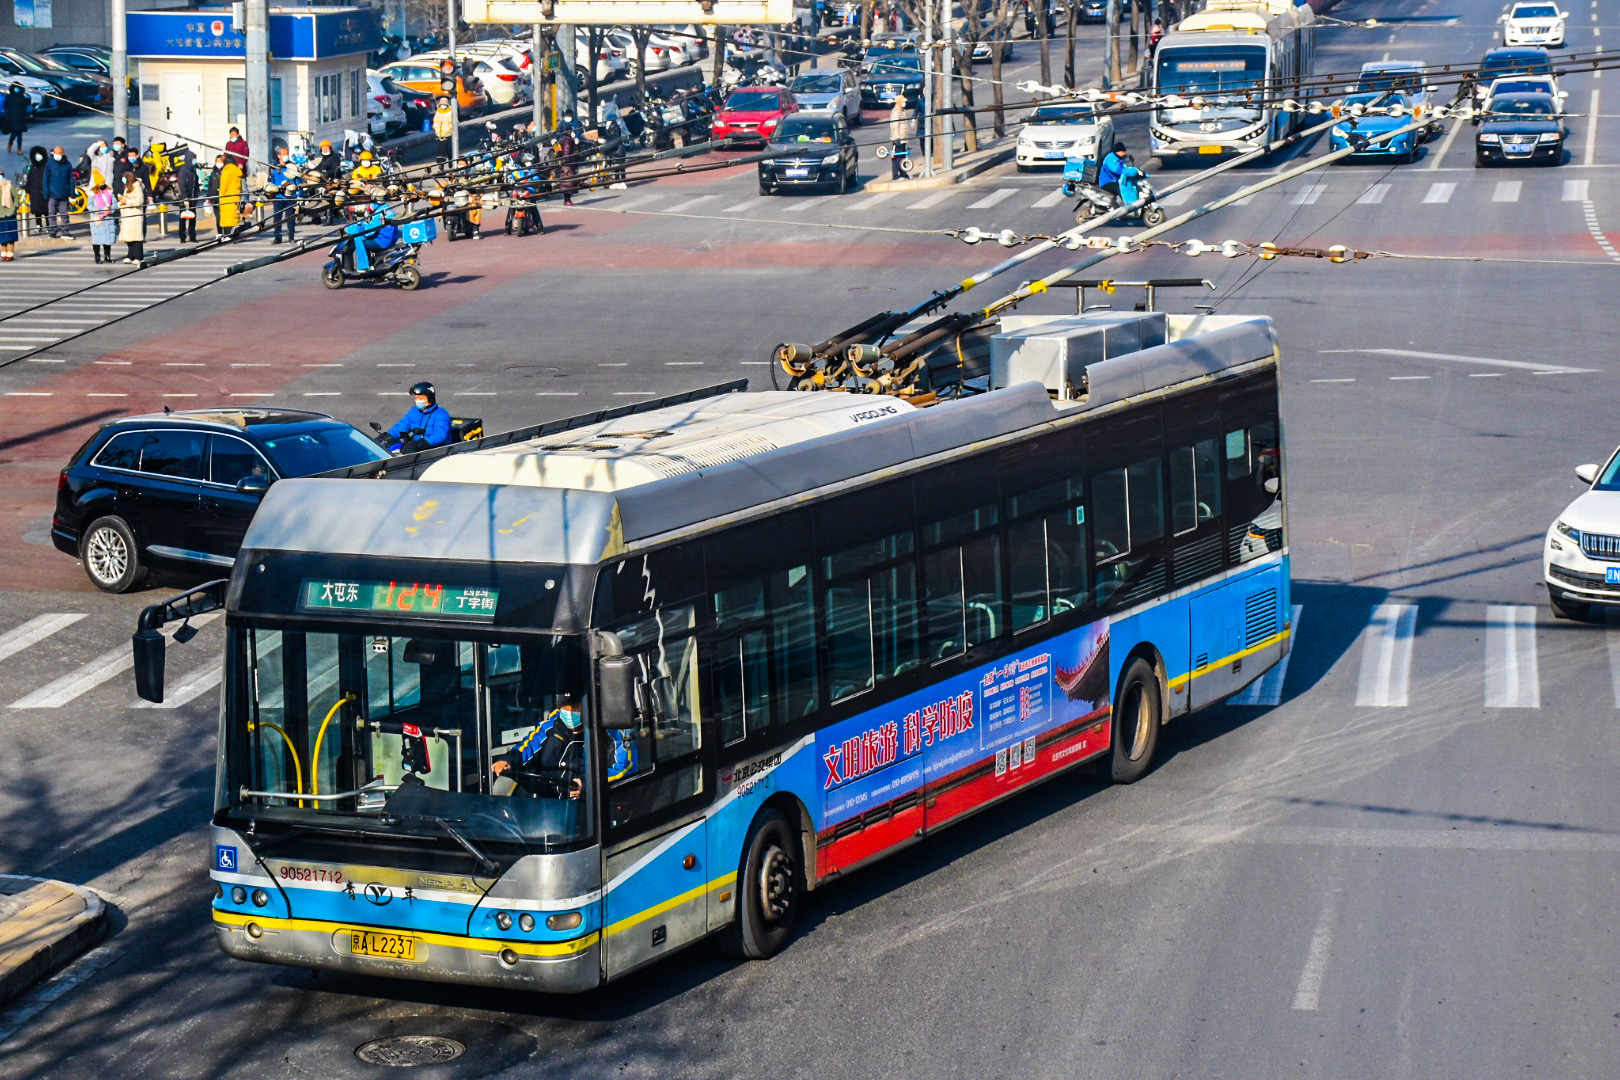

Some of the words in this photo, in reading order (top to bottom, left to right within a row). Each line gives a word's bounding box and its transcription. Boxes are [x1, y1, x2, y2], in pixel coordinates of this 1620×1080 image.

[321, 580, 360, 603] 大屯东
[386, 581, 443, 610] 124
[455, 596, 495, 610] 丁字街
[823, 720, 898, 789] 文明旅游
[903, 689, 974, 755] 科学防疫
[733, 752, 782, 783] 北京公交集团
[280, 866, 343, 884] 90521712
